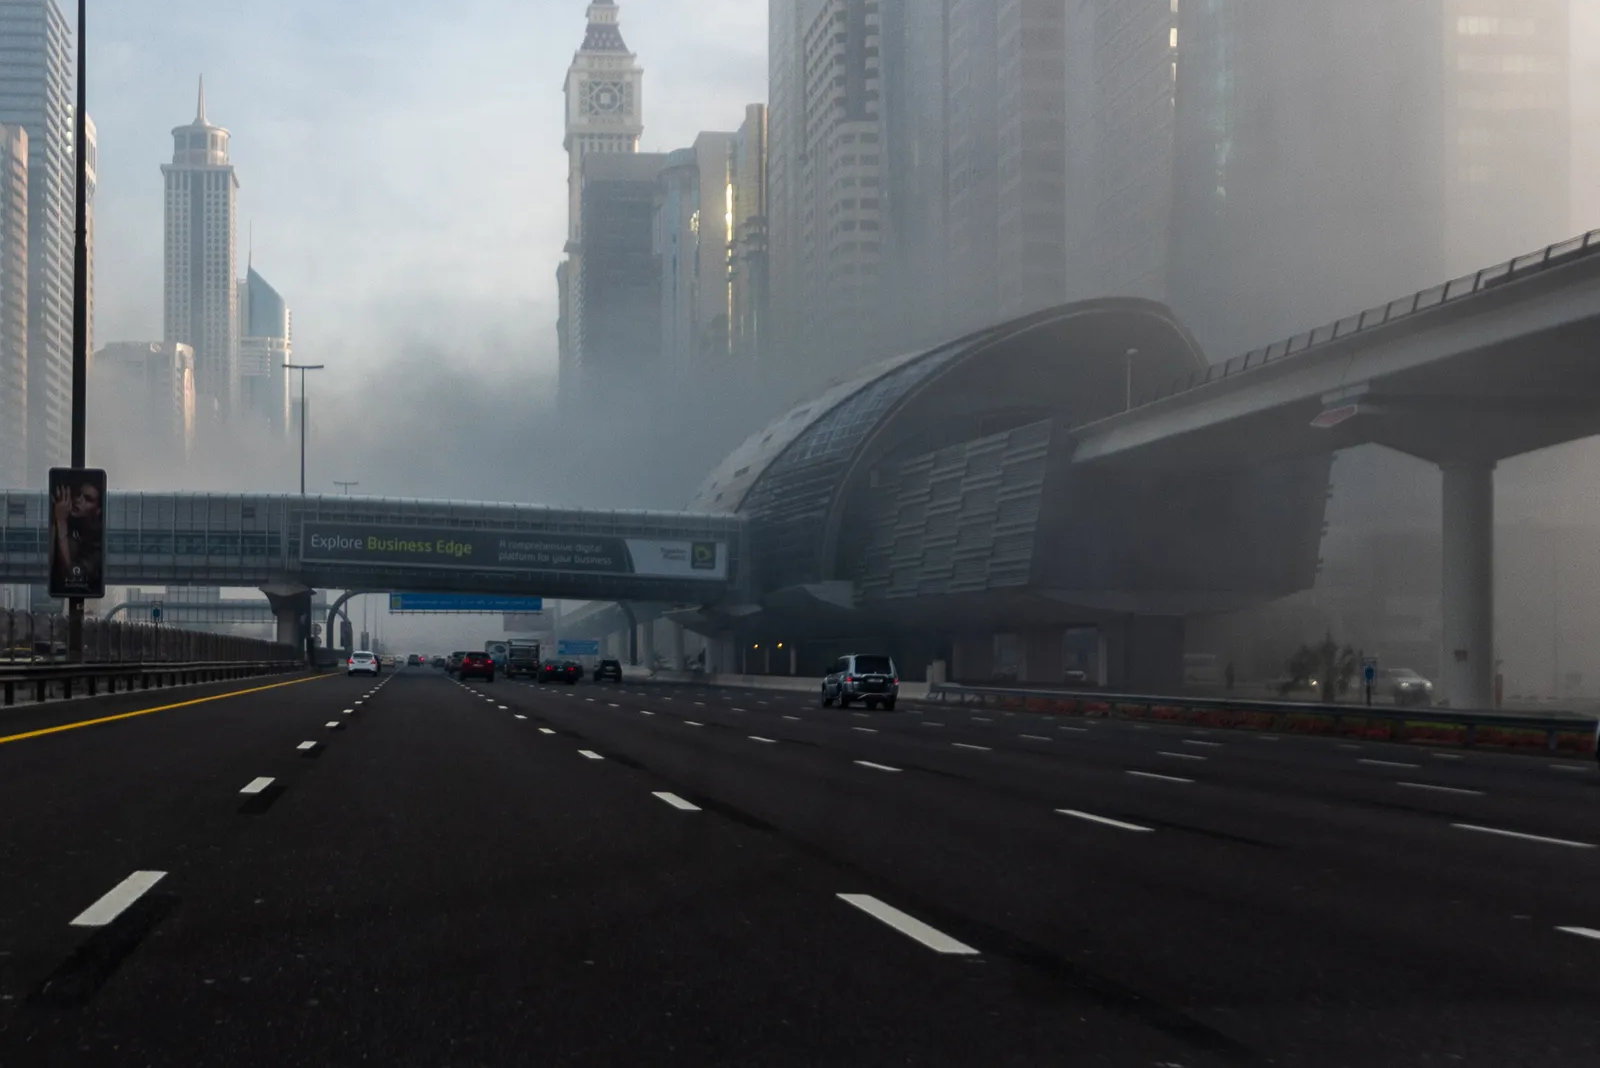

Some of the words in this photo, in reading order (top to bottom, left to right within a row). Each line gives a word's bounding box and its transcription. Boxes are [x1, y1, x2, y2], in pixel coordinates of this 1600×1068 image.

[311, 534, 363, 552] Explore
[367, 536, 432, 553] Business
[436, 540, 473, 557] Edge
[499, 538, 506, 549] A
[508, 540, 574, 552] comprehensive
[498, 551, 536, 562] platform
[537, 552, 550, 562] for
[552, 555, 572, 564] your
[574, 554, 613, 565] business
